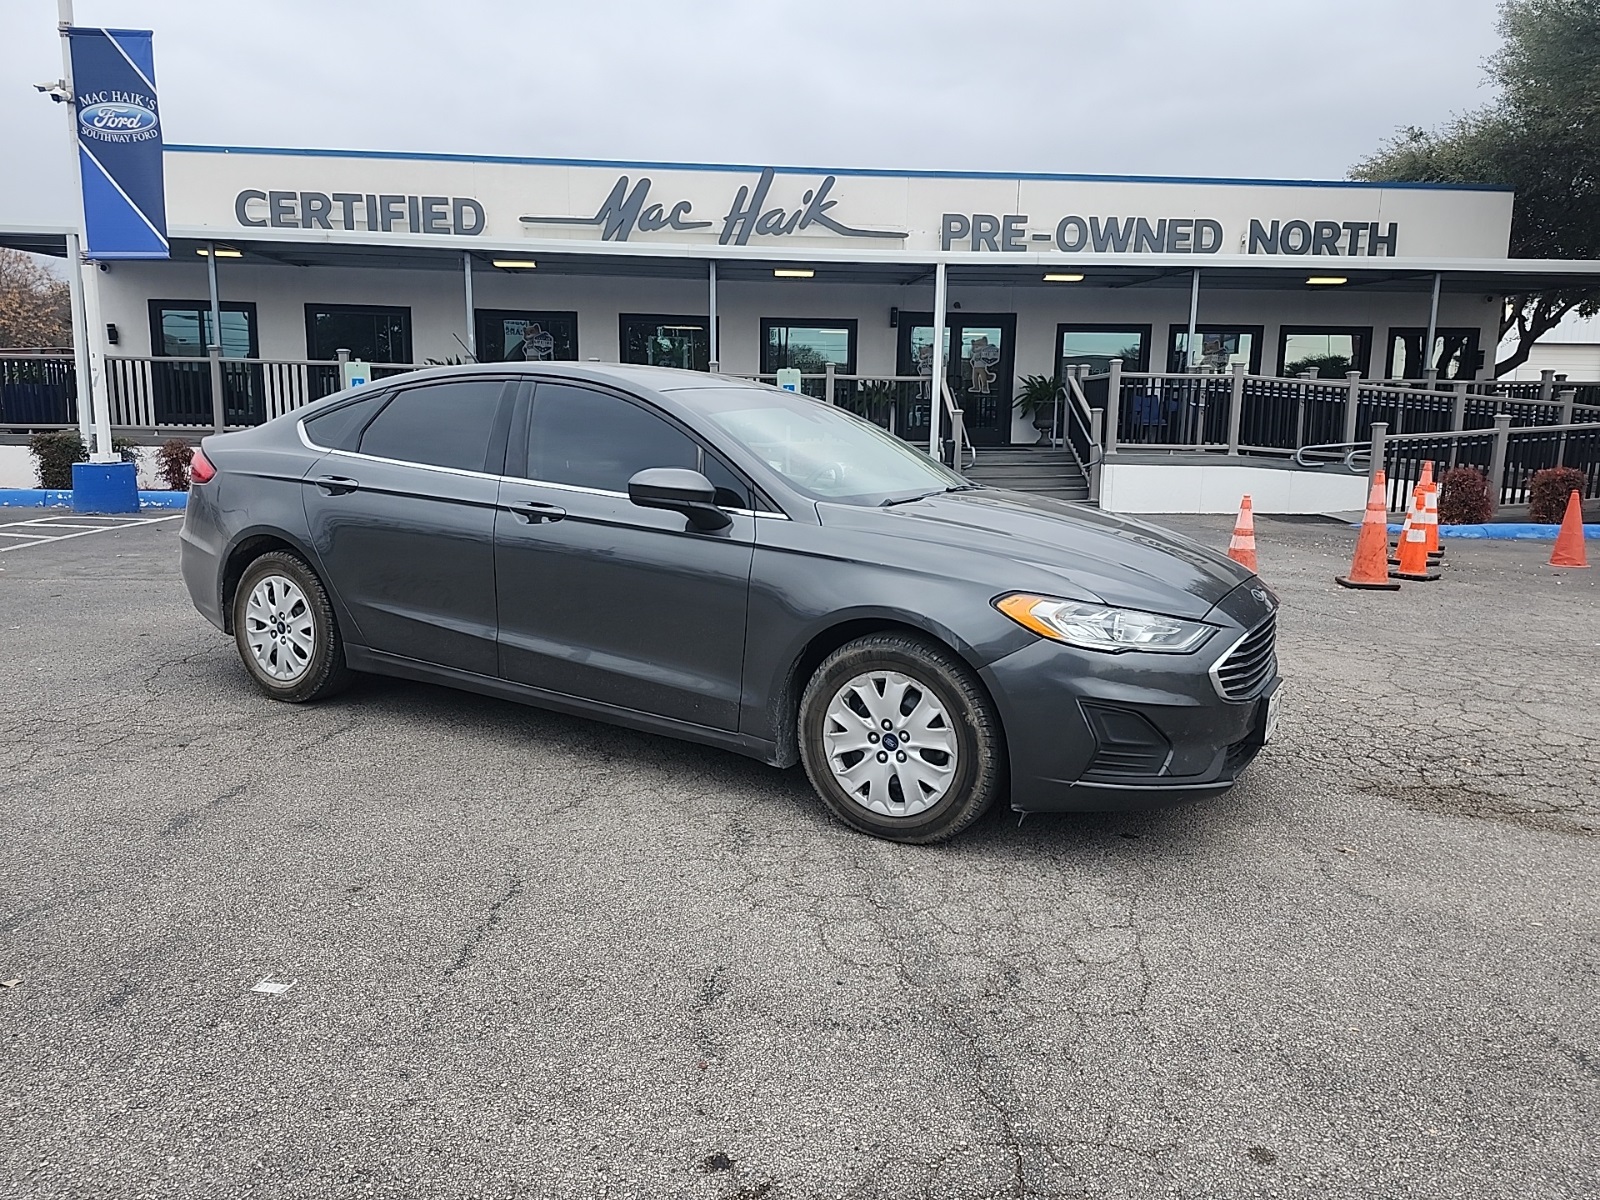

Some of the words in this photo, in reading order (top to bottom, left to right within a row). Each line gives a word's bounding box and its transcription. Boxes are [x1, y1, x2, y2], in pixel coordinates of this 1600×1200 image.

[79, 91, 108, 107] MAC
[112, 91, 157, 111] HAIK'S
[94, 107, 142, 129] Ford
[81, 127, 131, 143] SOUTHWAY
[132, 129, 158, 142] FORD
[235, 189, 486, 236] CERTIFIED
[519, 176, 713, 241] Mac
[718, 167, 910, 246] Haik
[941, 213, 1224, 253] PRE-OWNED
[1248, 219, 1398, 257] NORTH
